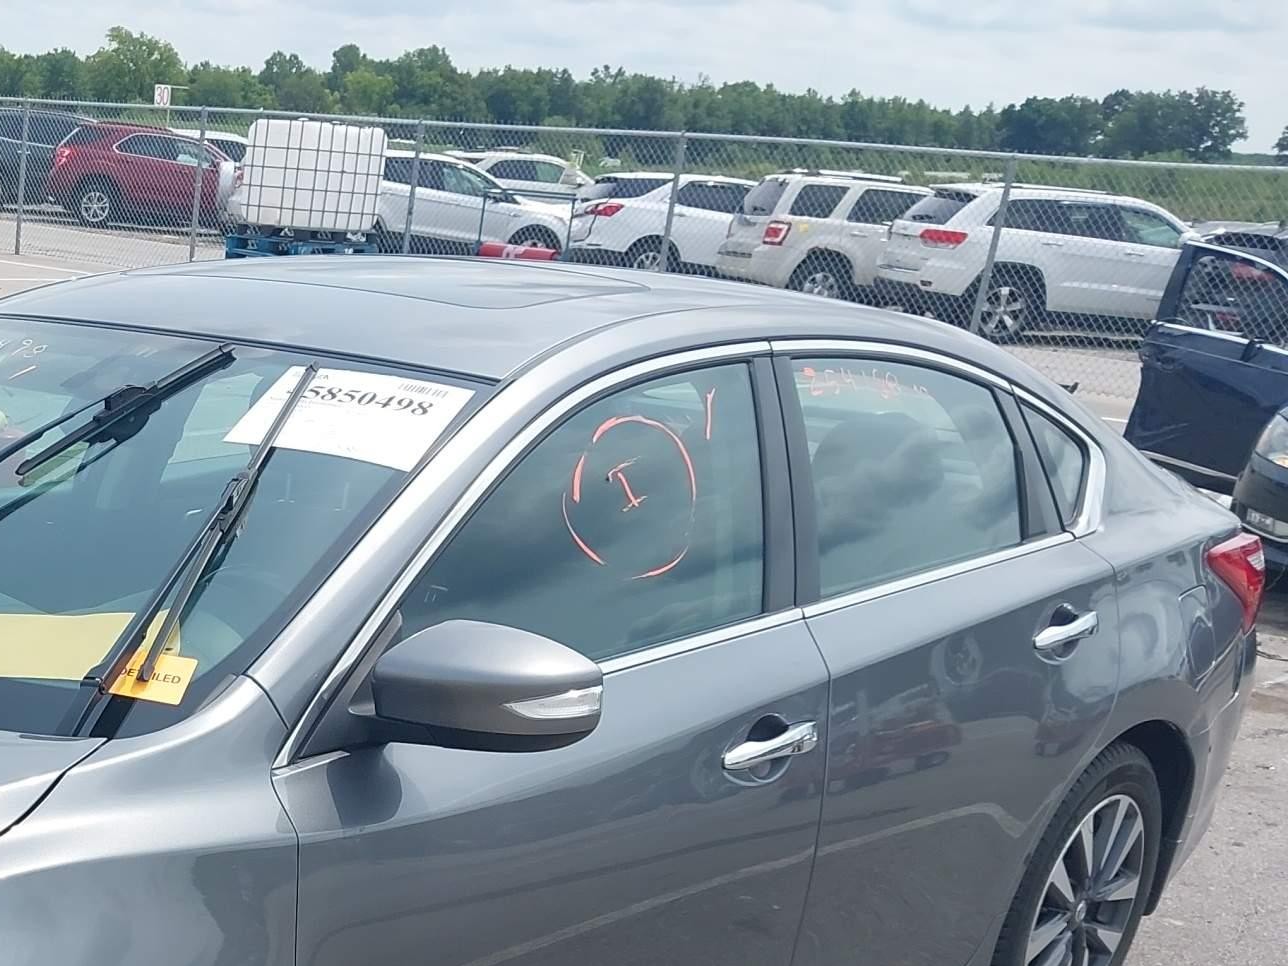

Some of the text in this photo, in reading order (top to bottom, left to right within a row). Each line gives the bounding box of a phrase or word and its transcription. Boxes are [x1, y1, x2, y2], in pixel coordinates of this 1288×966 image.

[156, 86, 169, 106] 30
[286, 385, 434, 417] 5850498
[120, 667, 182, 685] DEILED
